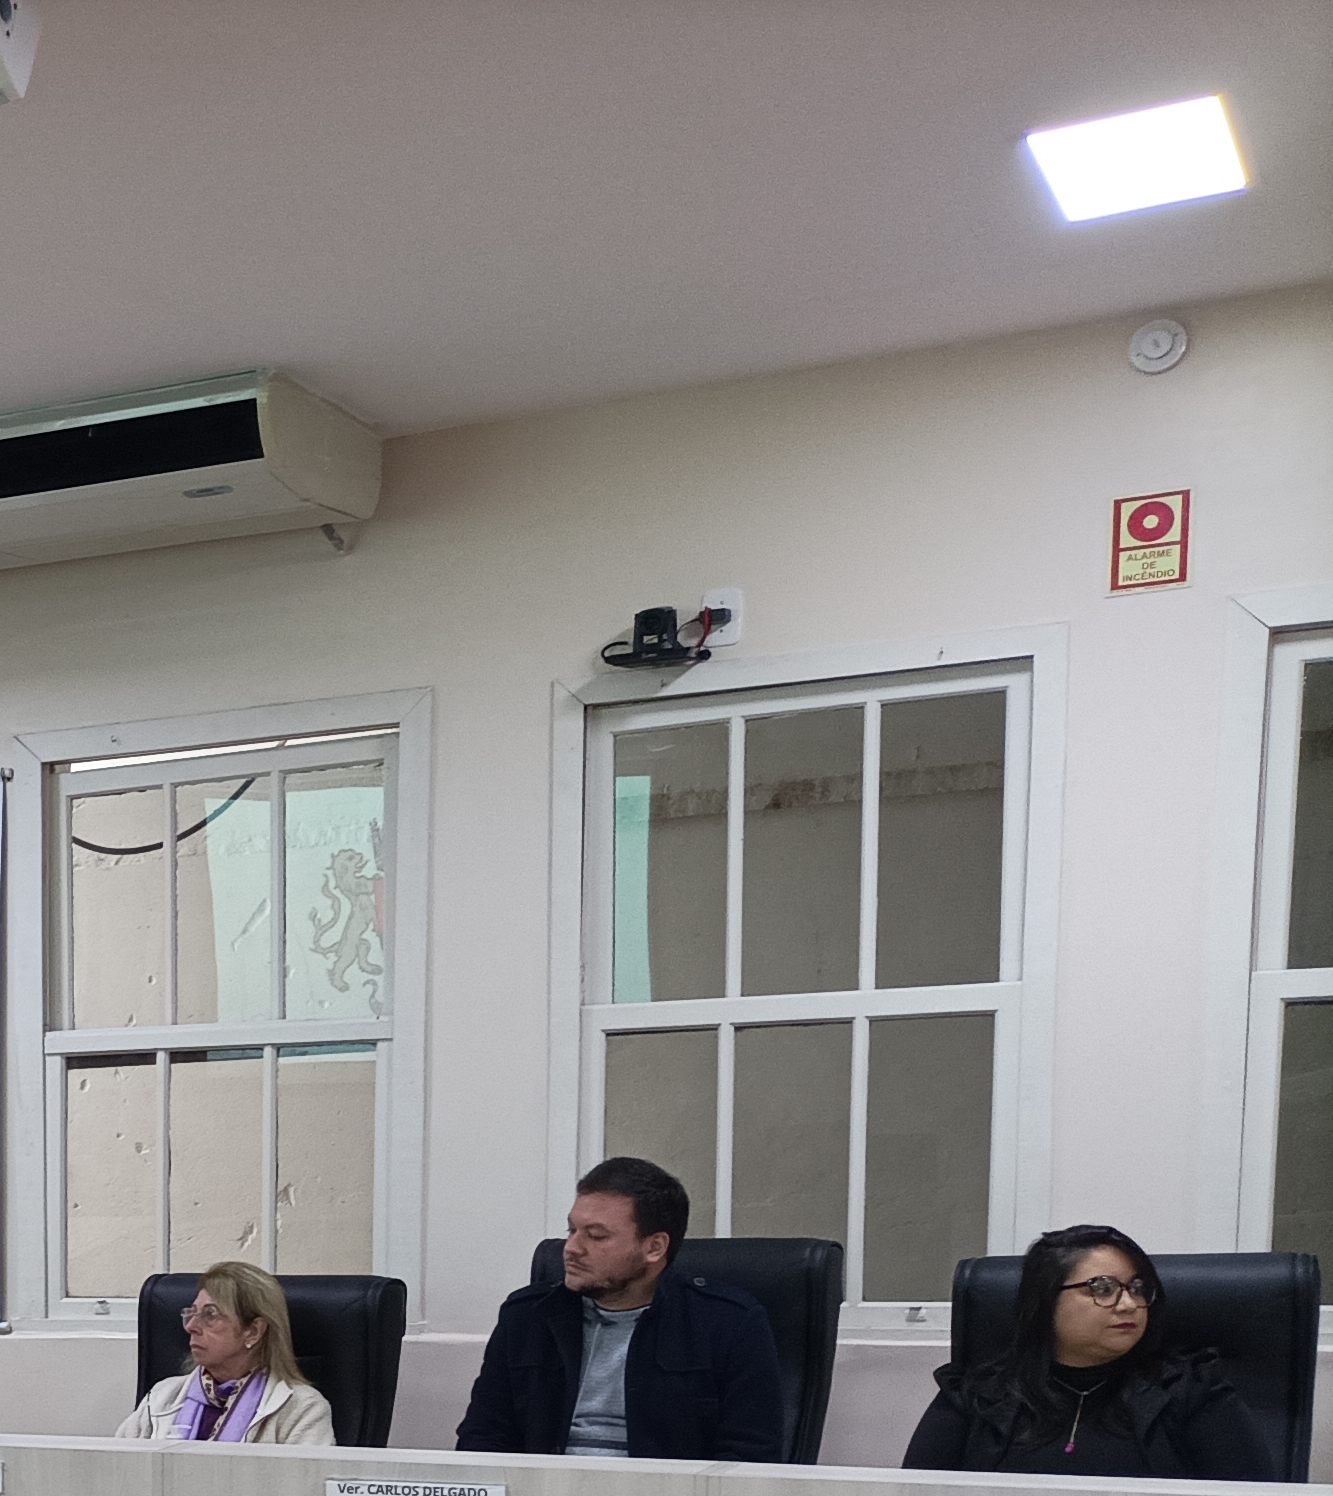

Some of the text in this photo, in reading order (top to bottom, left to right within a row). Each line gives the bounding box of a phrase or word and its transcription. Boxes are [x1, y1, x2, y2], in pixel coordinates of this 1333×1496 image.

[1126, 549, 1173, 562] ALARME
[1141, 561, 1157, 570] DE
[1122, 569, 1176, 583] INCÊNDIO
[337, 1483, 364, 1495] Ver.
[367, 1483, 420, 1496] CARLOS
